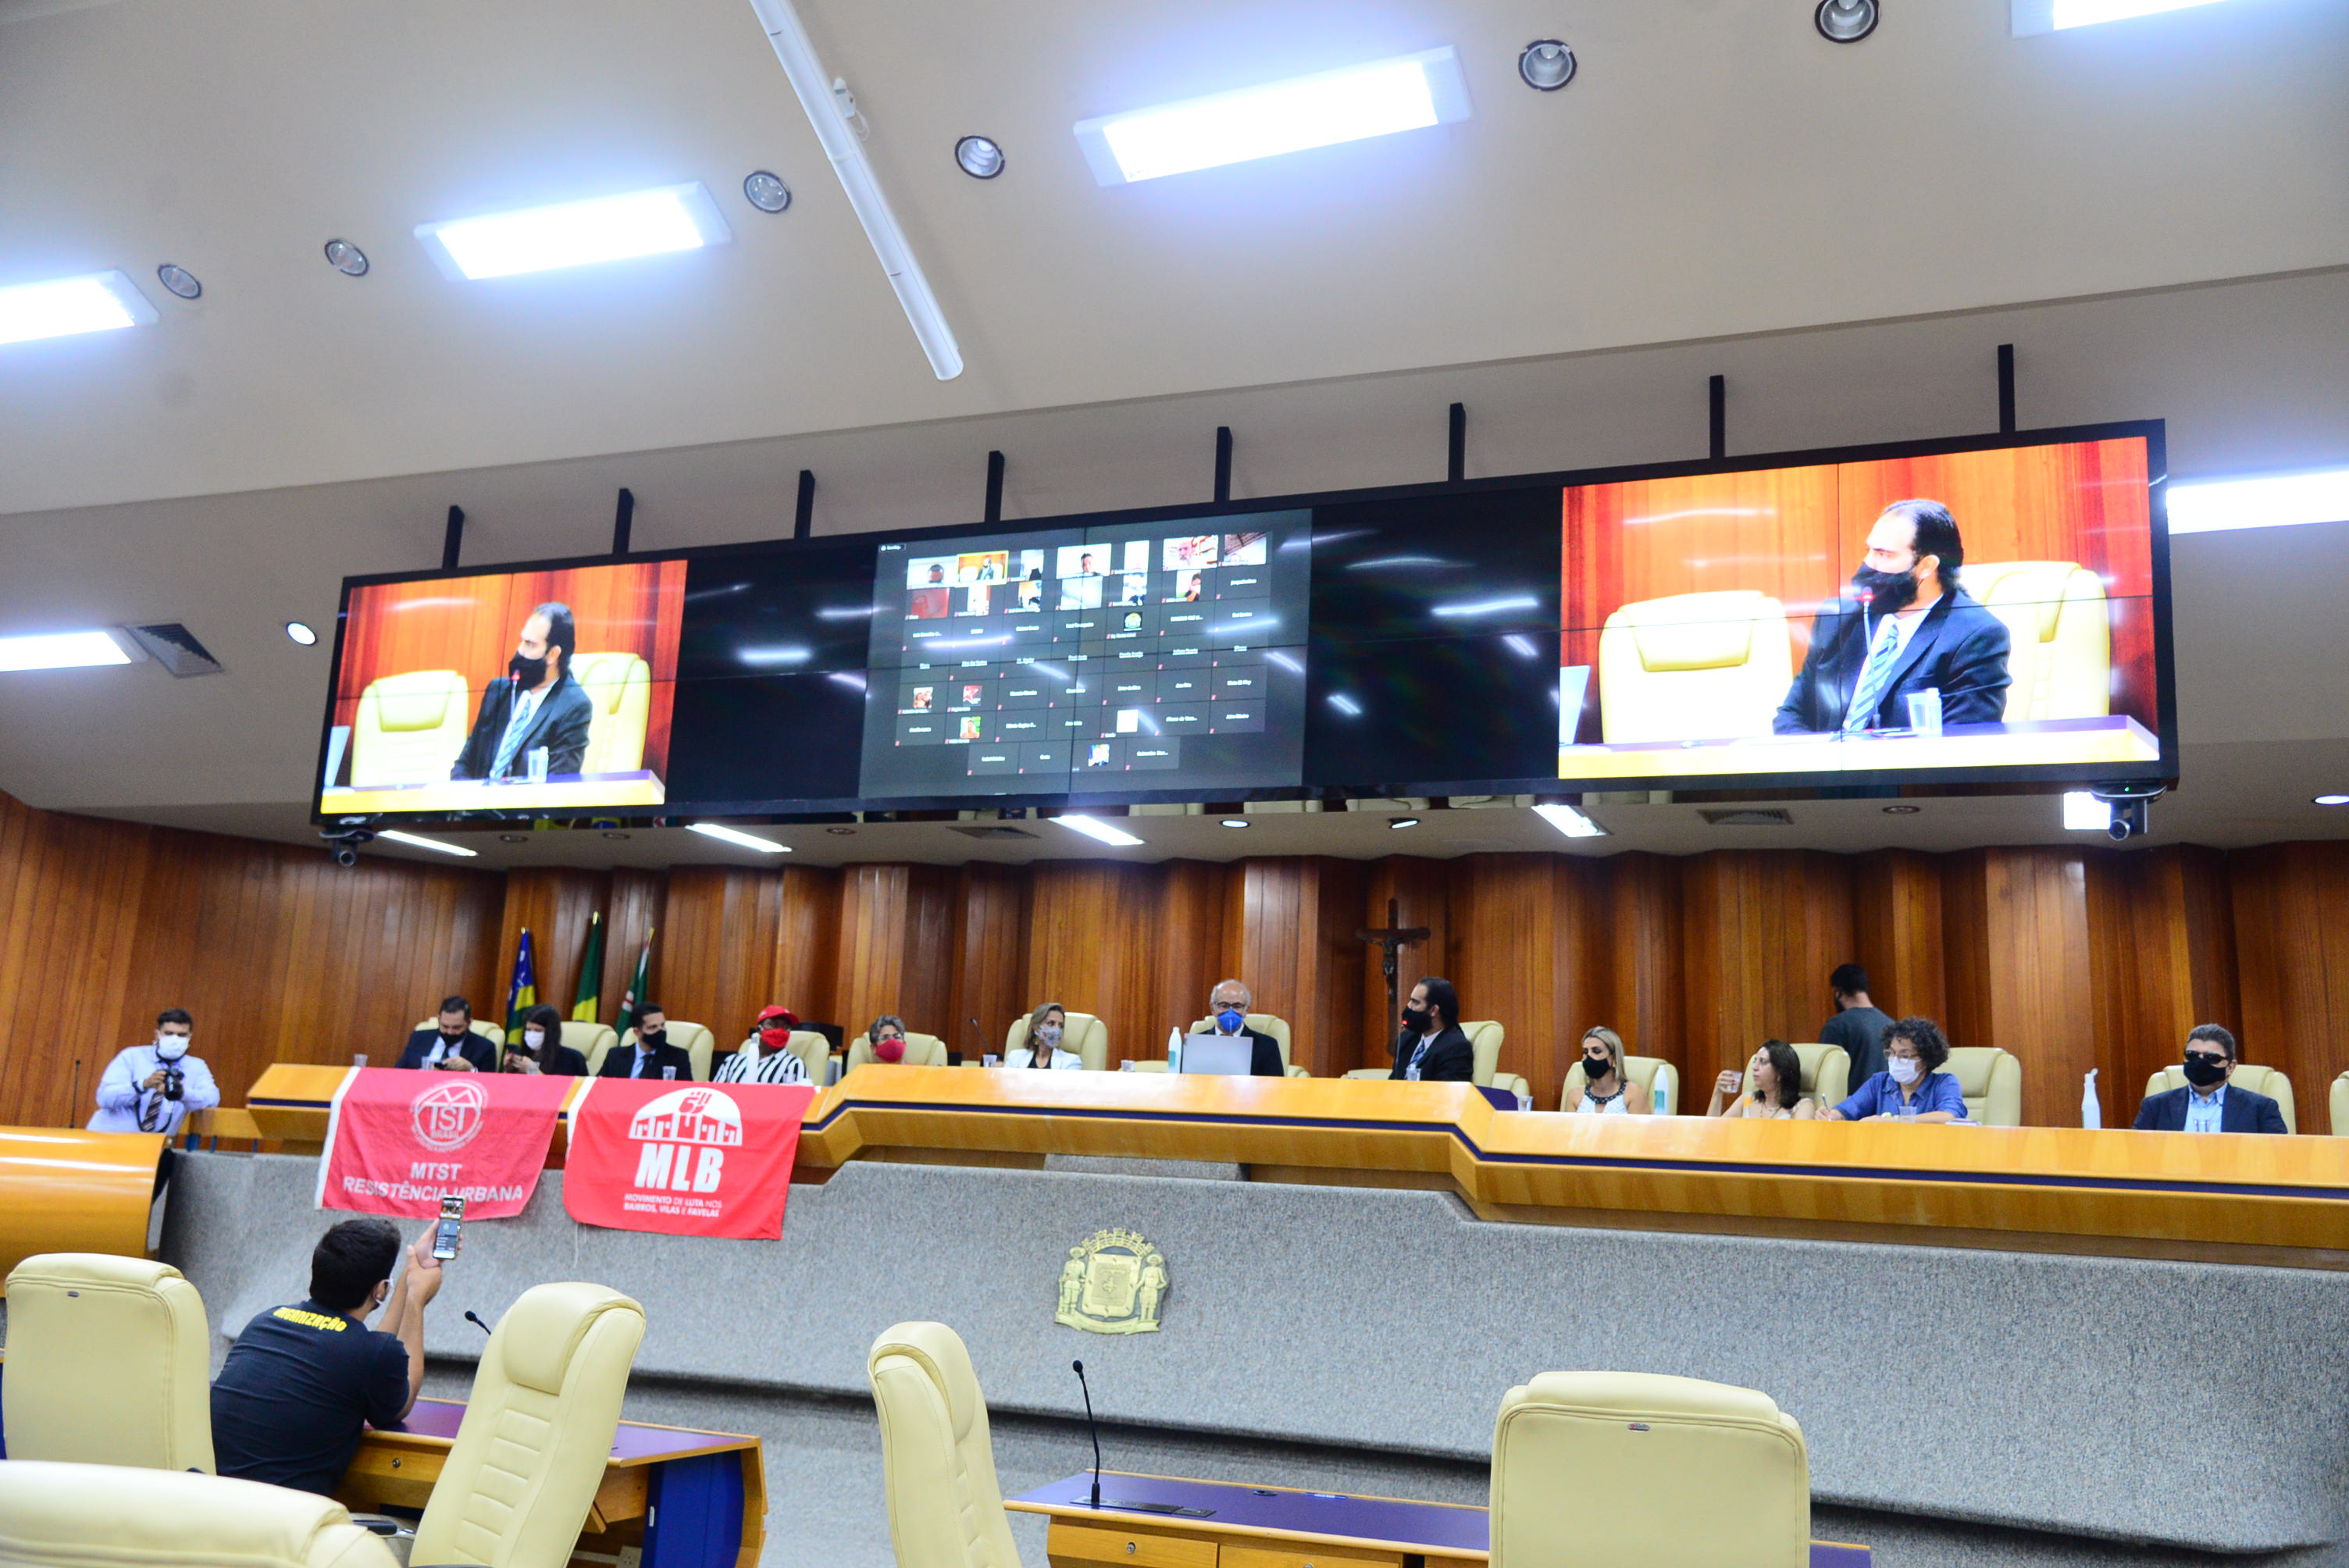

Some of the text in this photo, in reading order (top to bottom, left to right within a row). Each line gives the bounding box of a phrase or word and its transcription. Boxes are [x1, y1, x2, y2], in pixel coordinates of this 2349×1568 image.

[411, 1162, 462, 1181] MTST
[635, 1143, 724, 1192] MLB
[343, 1177, 522, 1202] RESISTÊNCIA URBANA
[623, 1202, 658, 1213] BAIRROS,
[659, 1204, 680, 1214] VILAS
[687, 1207, 719, 1217] FAVELAS
[624, 1193, 722, 1209] MOVIMENTO DE LUTA NOS
